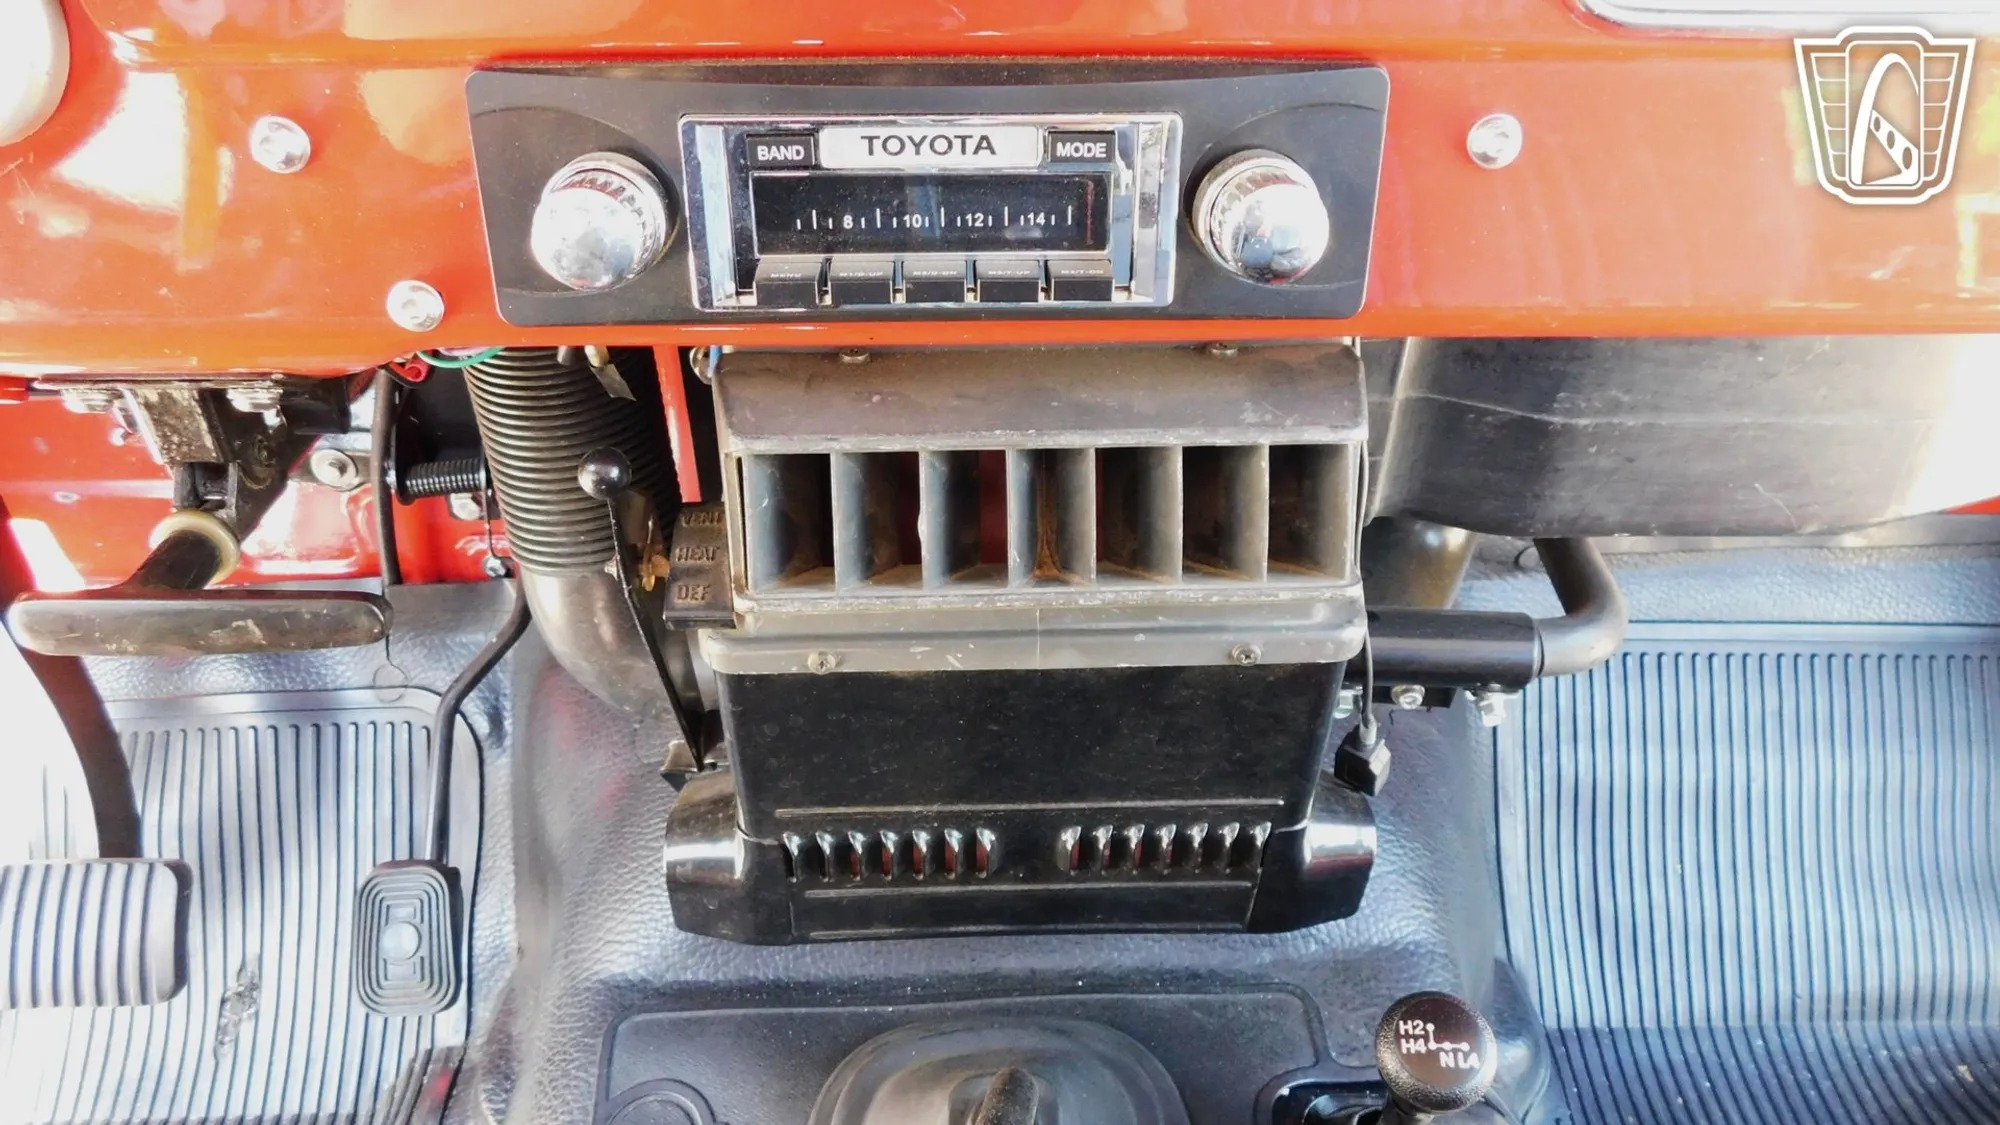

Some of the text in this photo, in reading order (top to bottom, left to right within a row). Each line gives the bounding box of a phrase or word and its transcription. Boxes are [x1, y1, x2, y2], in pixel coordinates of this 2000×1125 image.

[756, 145, 805, 161] BAND
[860, 134, 997, 157] TOYOTA
[1056, 141, 1107, 158] MODE
[843, 211, 1046, 229] 8 10 12 14
[675, 545, 720, 562] HEAT
[676, 584, 712, 602] DEF
[1398, 1019, 1425, 1036] H2
[1400, 1038, 1427, 1055] H4
[1439, 1051, 1455, 1068] N
